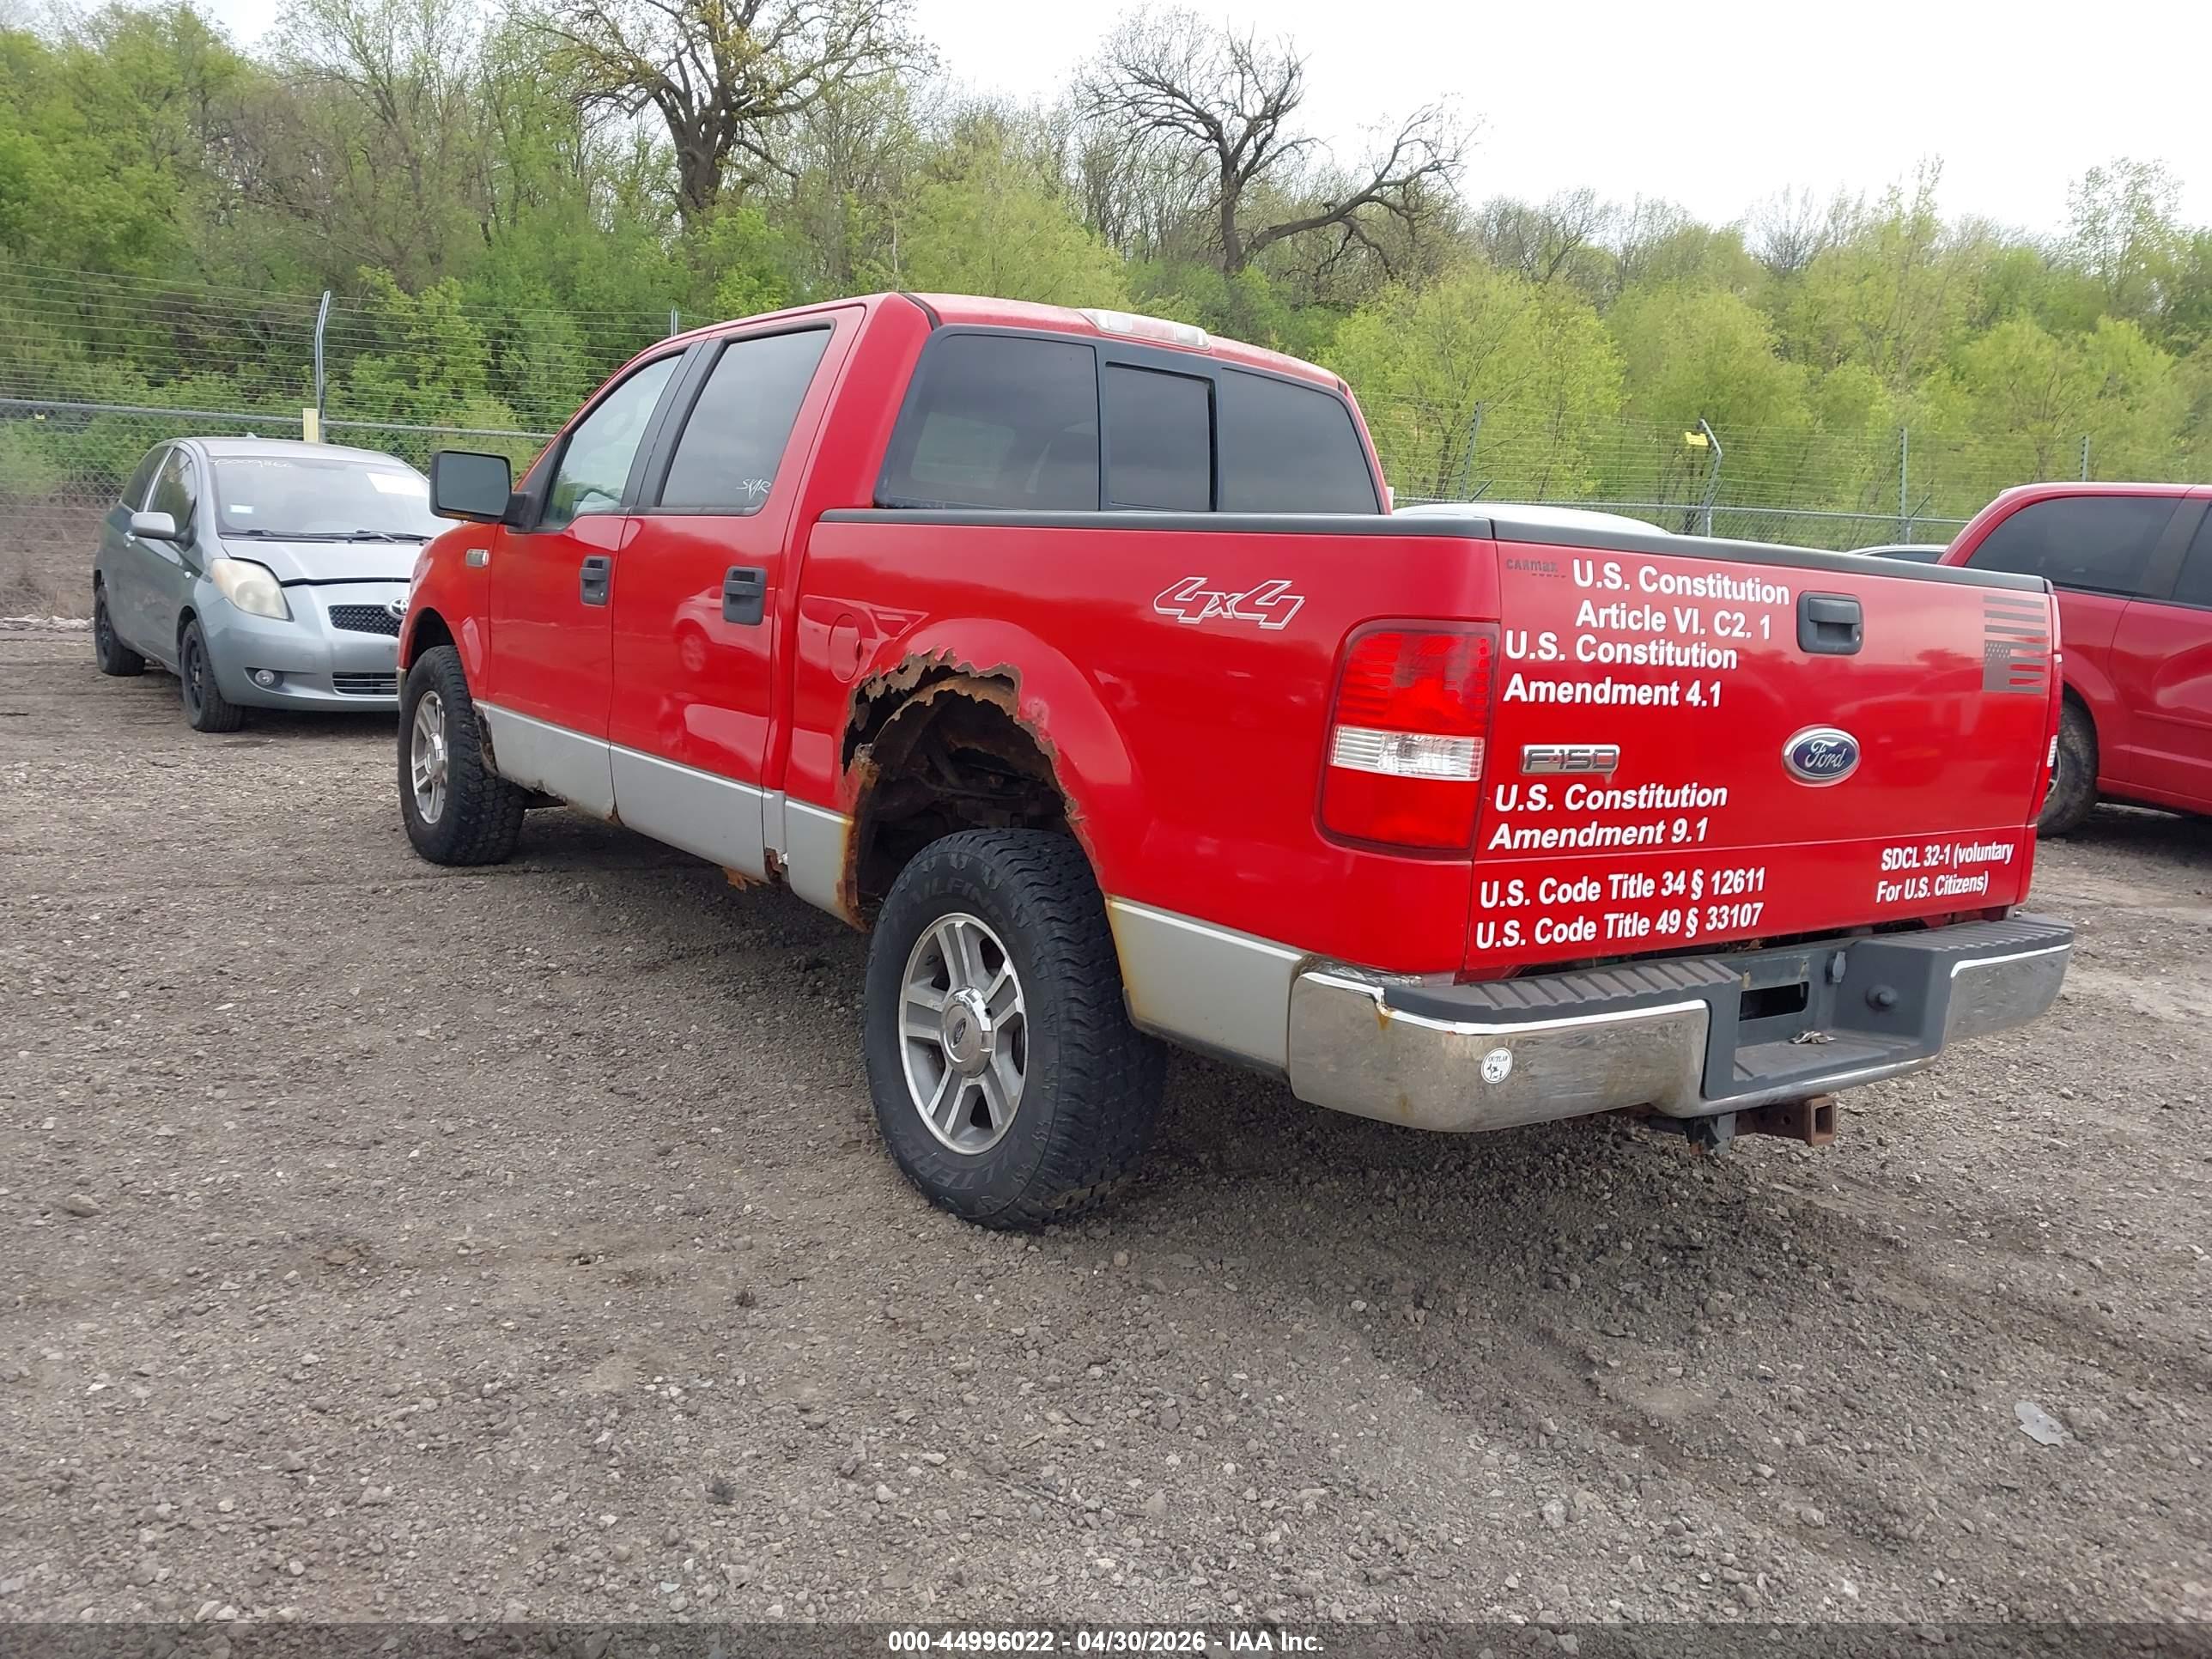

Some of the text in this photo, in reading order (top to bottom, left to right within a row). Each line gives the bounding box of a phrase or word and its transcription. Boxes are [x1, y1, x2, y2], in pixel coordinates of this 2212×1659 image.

[1572, 558, 1790, 605] U.S. Constitution
[1153, 576, 1306, 630] 4x4
[1575, 599, 1770, 641] Article VI. C2. 1
[1505, 629, 1737, 670] U.S. Constitution
[1503, 672, 1721, 707] Amendment 4.1
[1495, 782, 1728, 811] U.S. Constitution
[1487, 817, 1708, 850] Amendment 9.1
[1881, 842, 2014, 871] SDCL 32-1 (voluntary
[1480, 866, 1765, 908] U.S. Code Title 34 § 12611
[1876, 871, 1989, 903] For U.S. Citizens)
[1476, 902, 1764, 949] U.S. Code Title 49 § 33107
